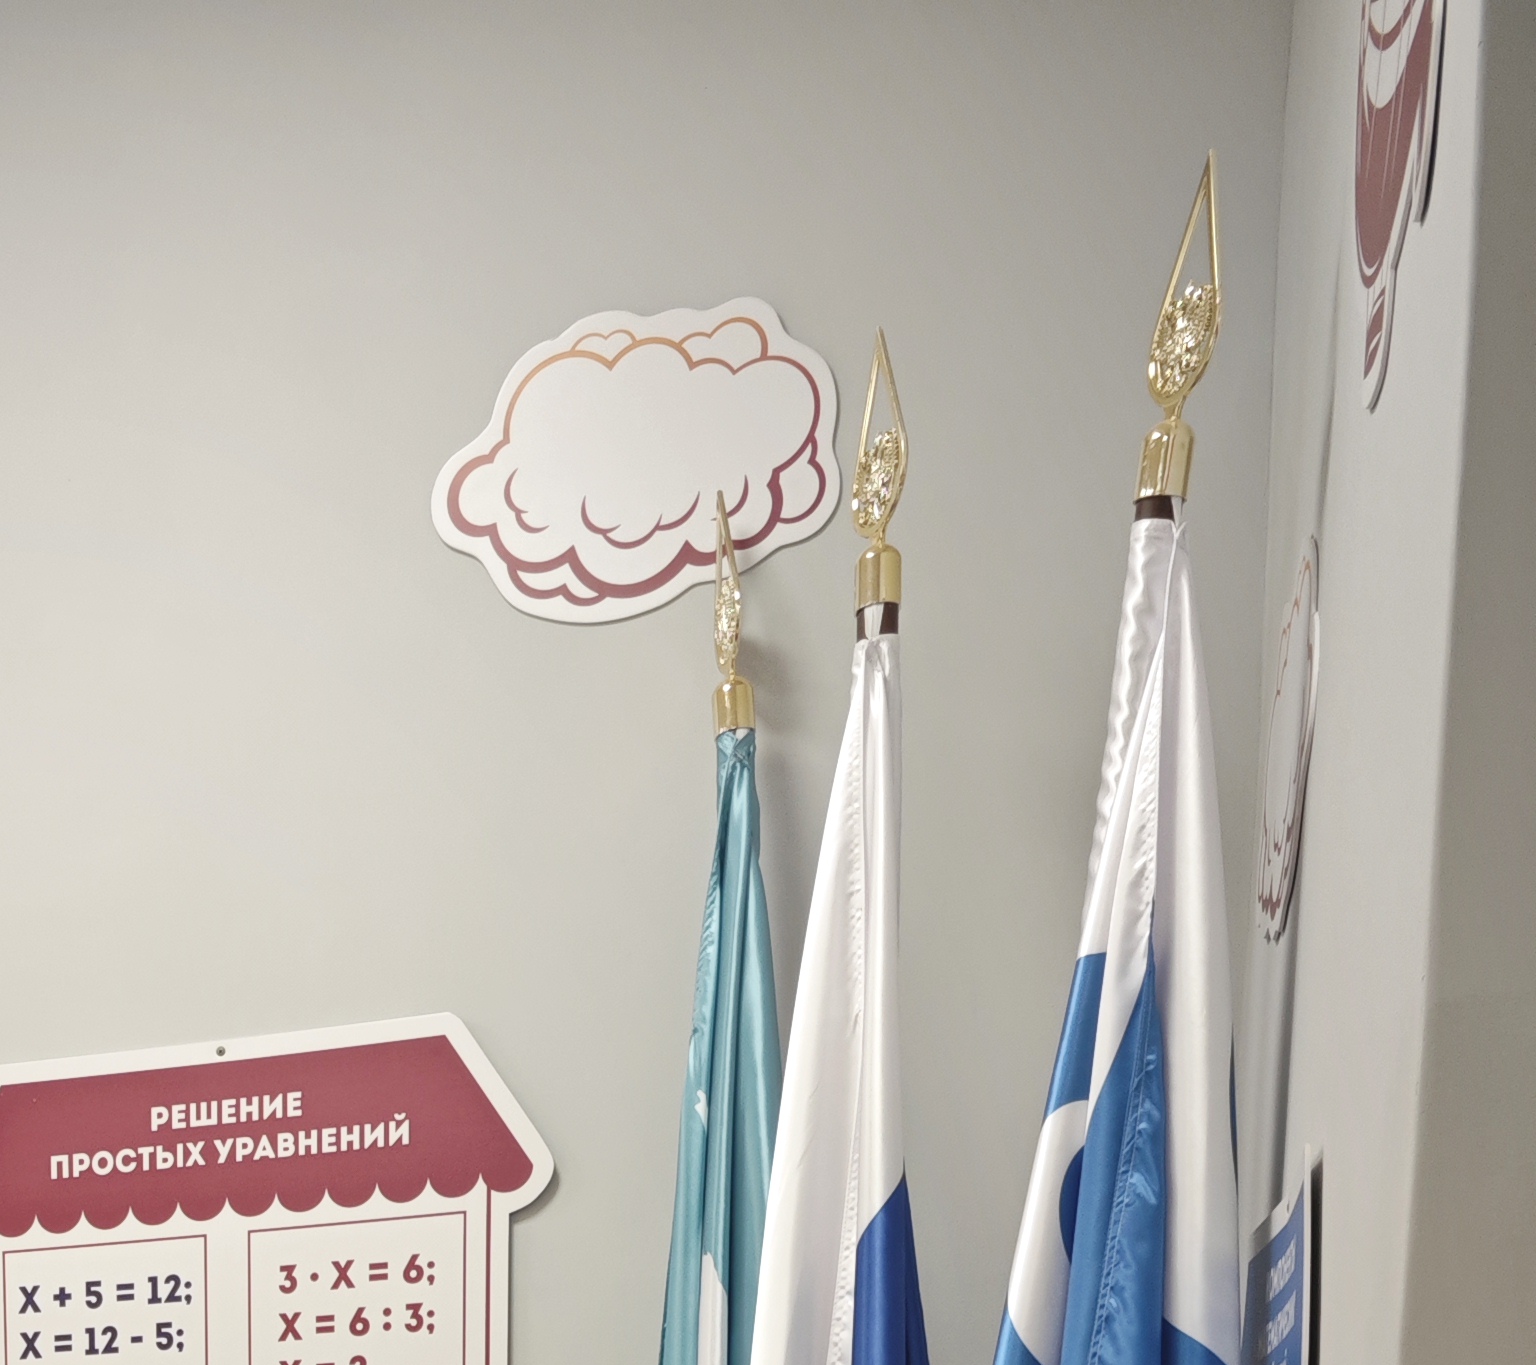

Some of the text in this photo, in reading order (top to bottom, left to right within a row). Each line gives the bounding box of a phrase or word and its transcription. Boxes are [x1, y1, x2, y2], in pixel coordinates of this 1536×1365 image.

[150, 1090, 304, 1133] РЕШЕНИЕ
[49, 1111, 411, 1181] ПРОСТЫХ УРАВНЕНИЙ
[52, 1286, 72, 1308] +
[85, 1280, 104, 1310] 5
[115, 1282, 135, 1302] =
[147, 1273, 193, 1306] 12;
[278, 1264, 298, 1295] 3
[368, 1261, 389, 1282] =
[402, 1253, 436, 1286] 6;
[53, 1333, 73, 1353] =
[84, 1325, 120, 1356] 12
[155, 1321, 185, 1353] 5;
[315, 1314, 335, 1334] =
[348, 1306, 371, 1337] 6
[382, 1307, 392, 1332] :
[404, 1302, 435, 1335] 3;
